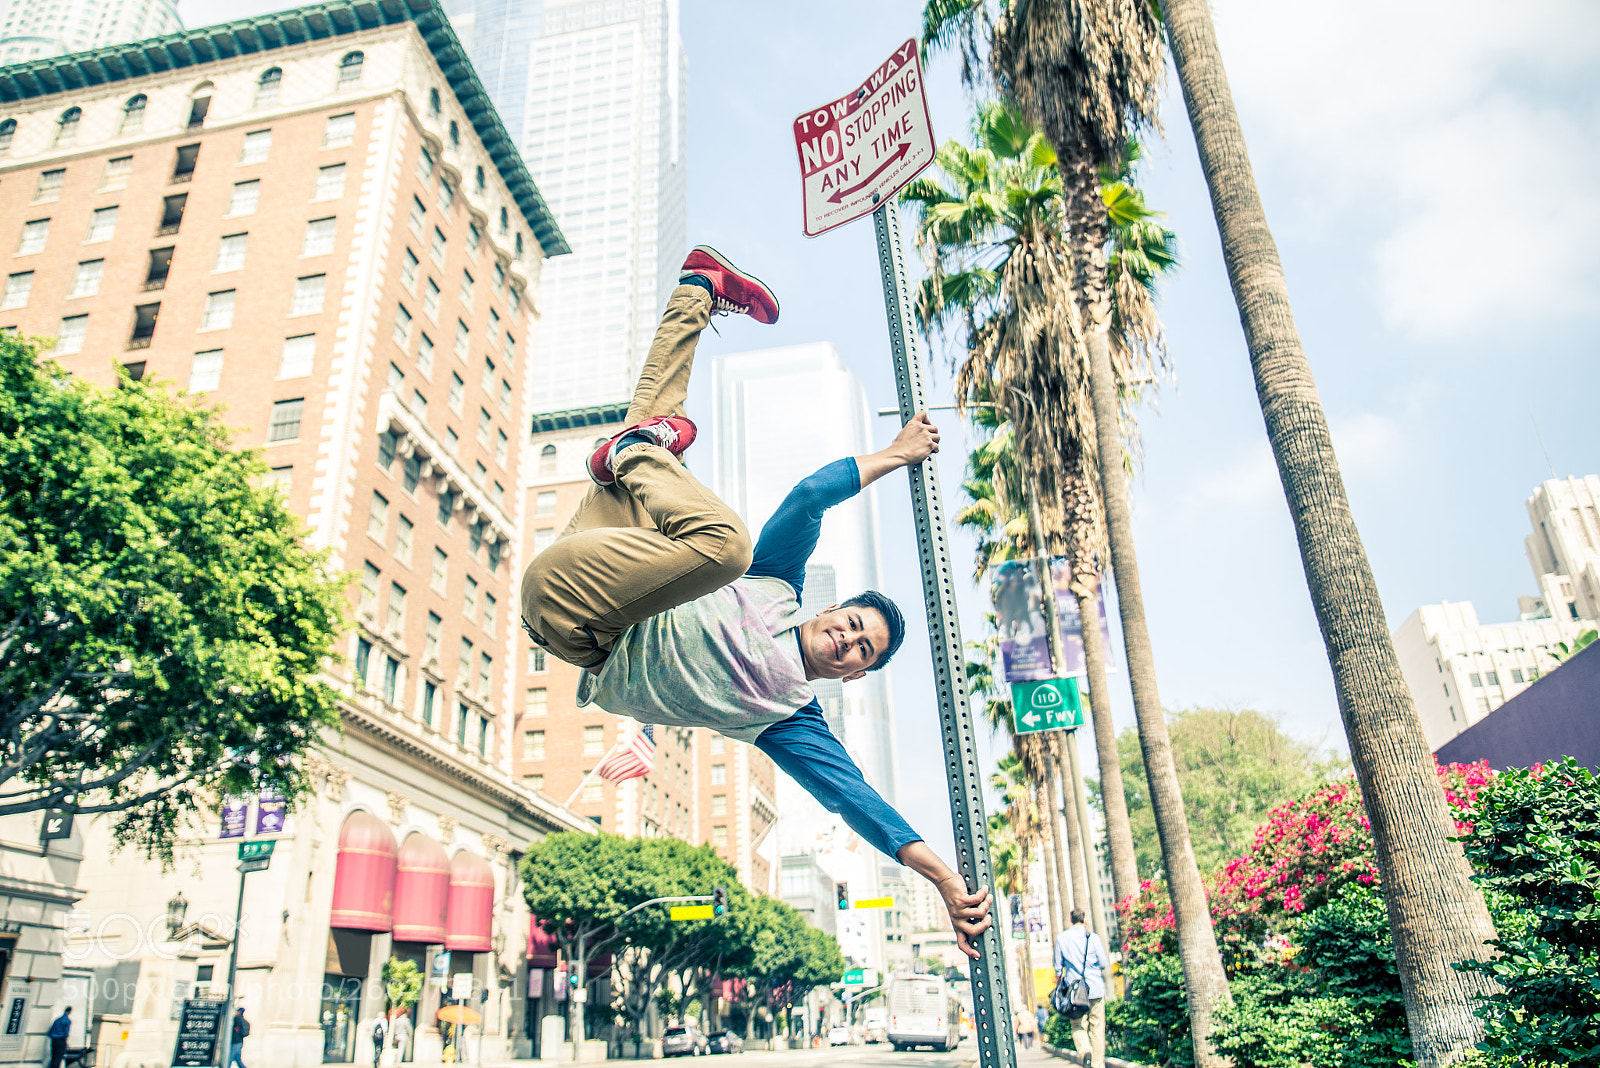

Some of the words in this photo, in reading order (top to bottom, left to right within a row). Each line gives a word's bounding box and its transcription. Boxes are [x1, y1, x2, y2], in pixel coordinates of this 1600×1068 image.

[797, 41, 911, 133] TOW-AWAY
[800, 130, 840, 174] NO
[845, 69, 916, 147] STOPPING
[821, 154, 861, 193] ANY
[871, 110, 913, 159] TIME
[823, 204, 849, 218] RECOVER
[850, 187, 879, 206] IMPOUNDED
[879, 169, 900, 189] VEHICLES
[899, 159, 912, 171] CALL
[1038, 692, 1056, 704] 110
[1046, 709, 1076, 725] Fwy
